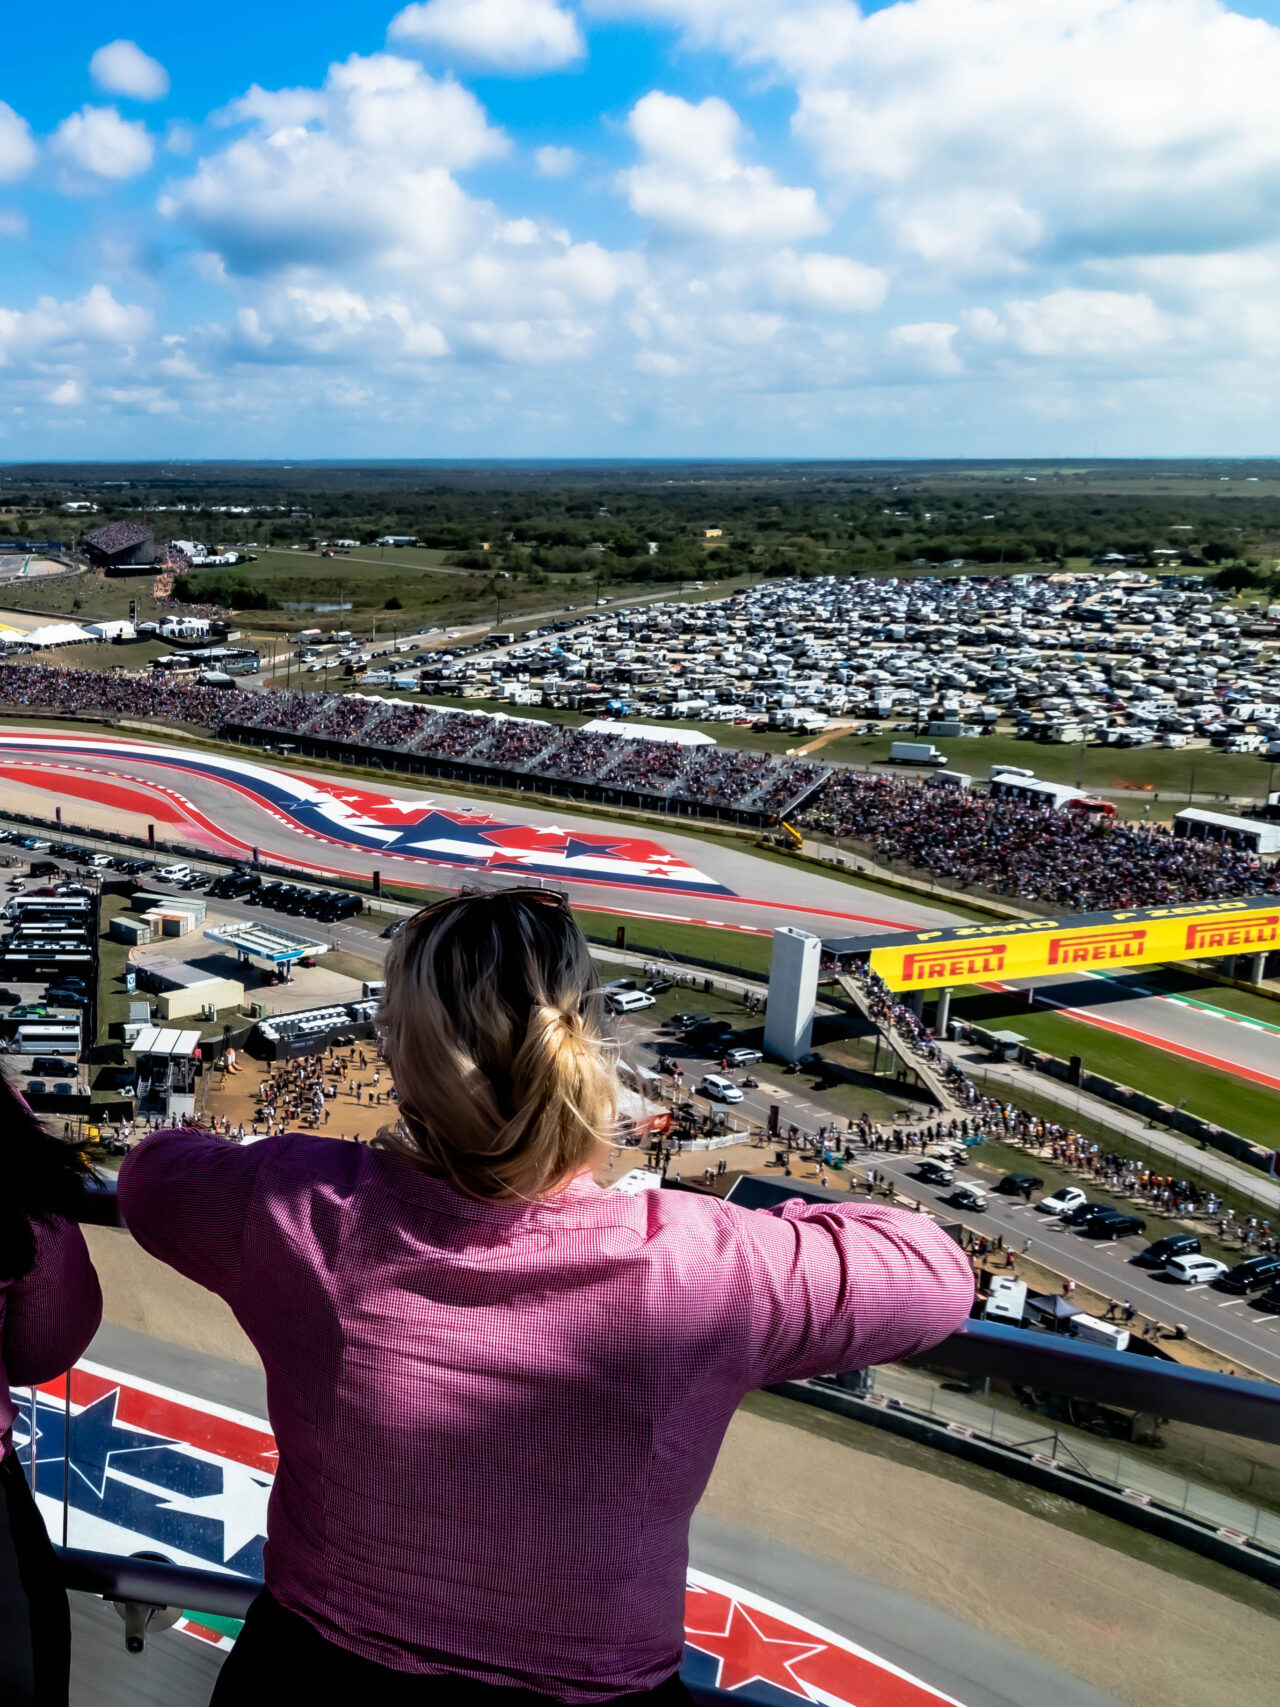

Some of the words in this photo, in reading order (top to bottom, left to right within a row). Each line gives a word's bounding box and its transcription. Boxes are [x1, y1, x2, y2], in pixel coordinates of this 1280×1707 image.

[1113, 912, 1137, 921] P
[1150, 901, 1248, 918] ZERO
[917, 931, 943, 942] P
[953, 920, 1060, 935] ZERO
[1047, 930, 1147, 965] PIRELLI
[1185, 916, 1280, 951] PIRELLI
[901, 944, 1008, 982] PIRELLI
